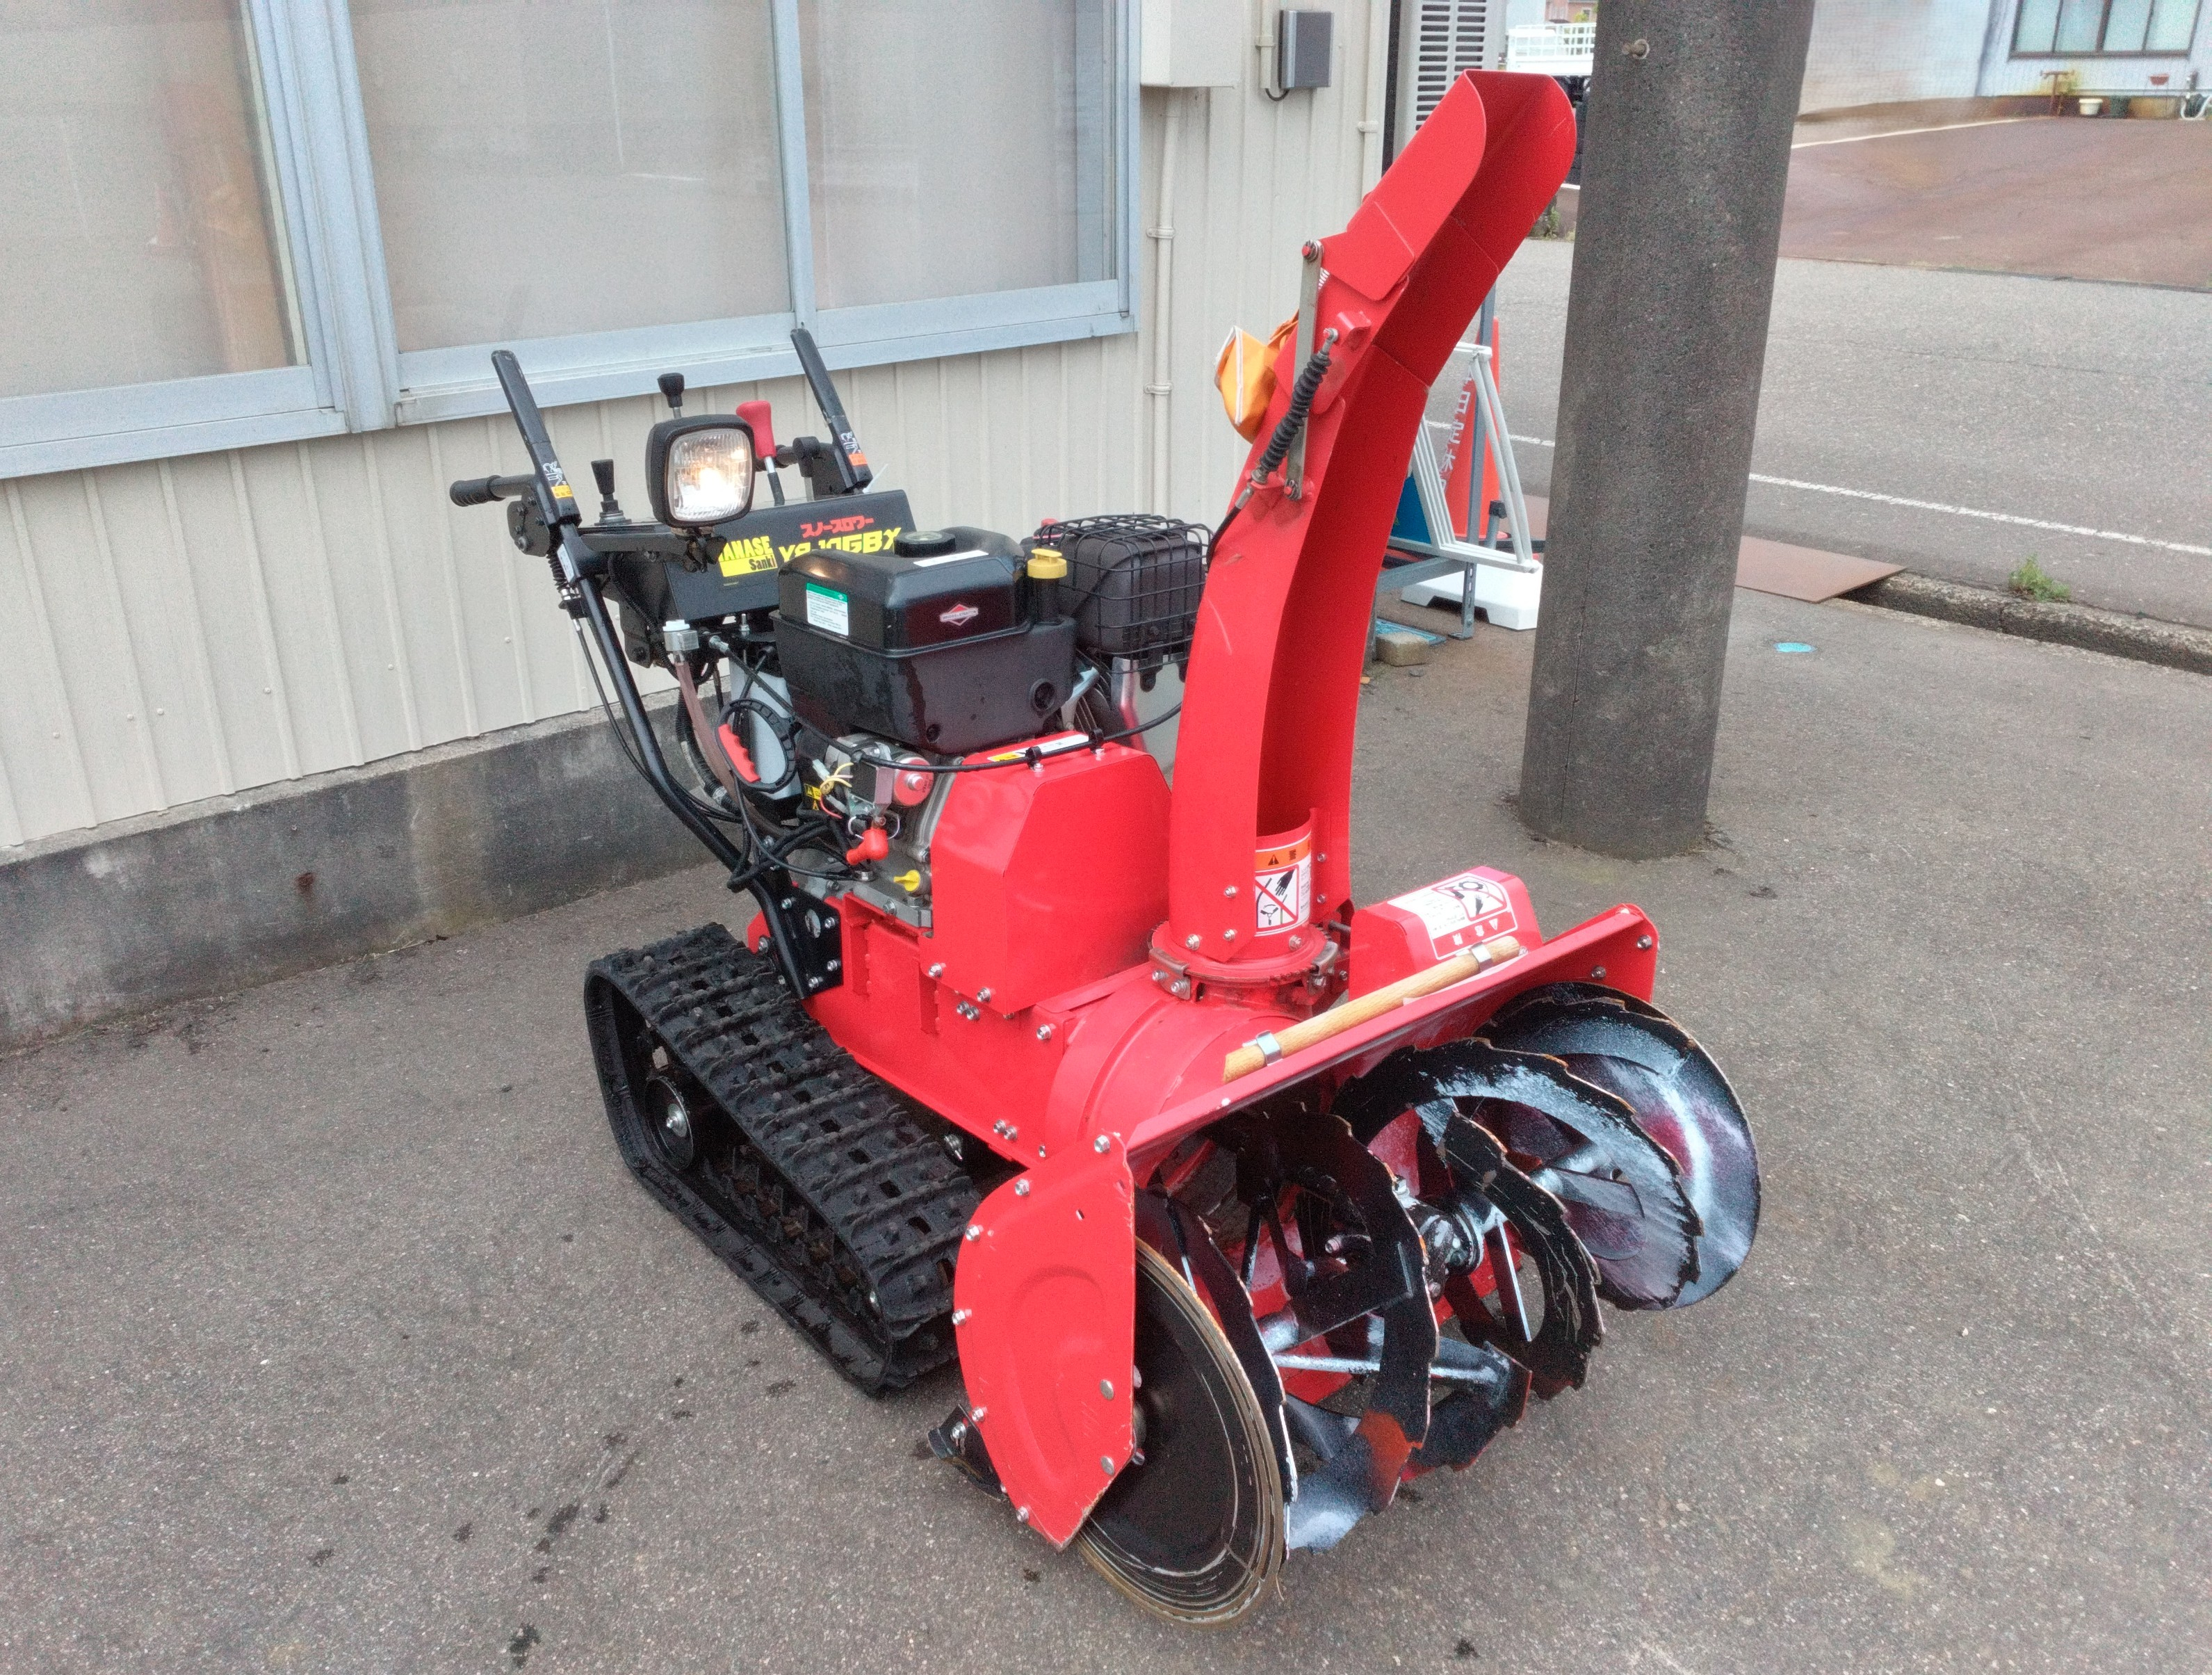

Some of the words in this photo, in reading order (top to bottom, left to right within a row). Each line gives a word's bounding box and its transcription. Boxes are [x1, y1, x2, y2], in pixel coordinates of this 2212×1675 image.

[800, 515, 875, 538] スノースロワー
[719, 535, 772, 562] ANASE
[749, 554, 776, 571] Sanki
